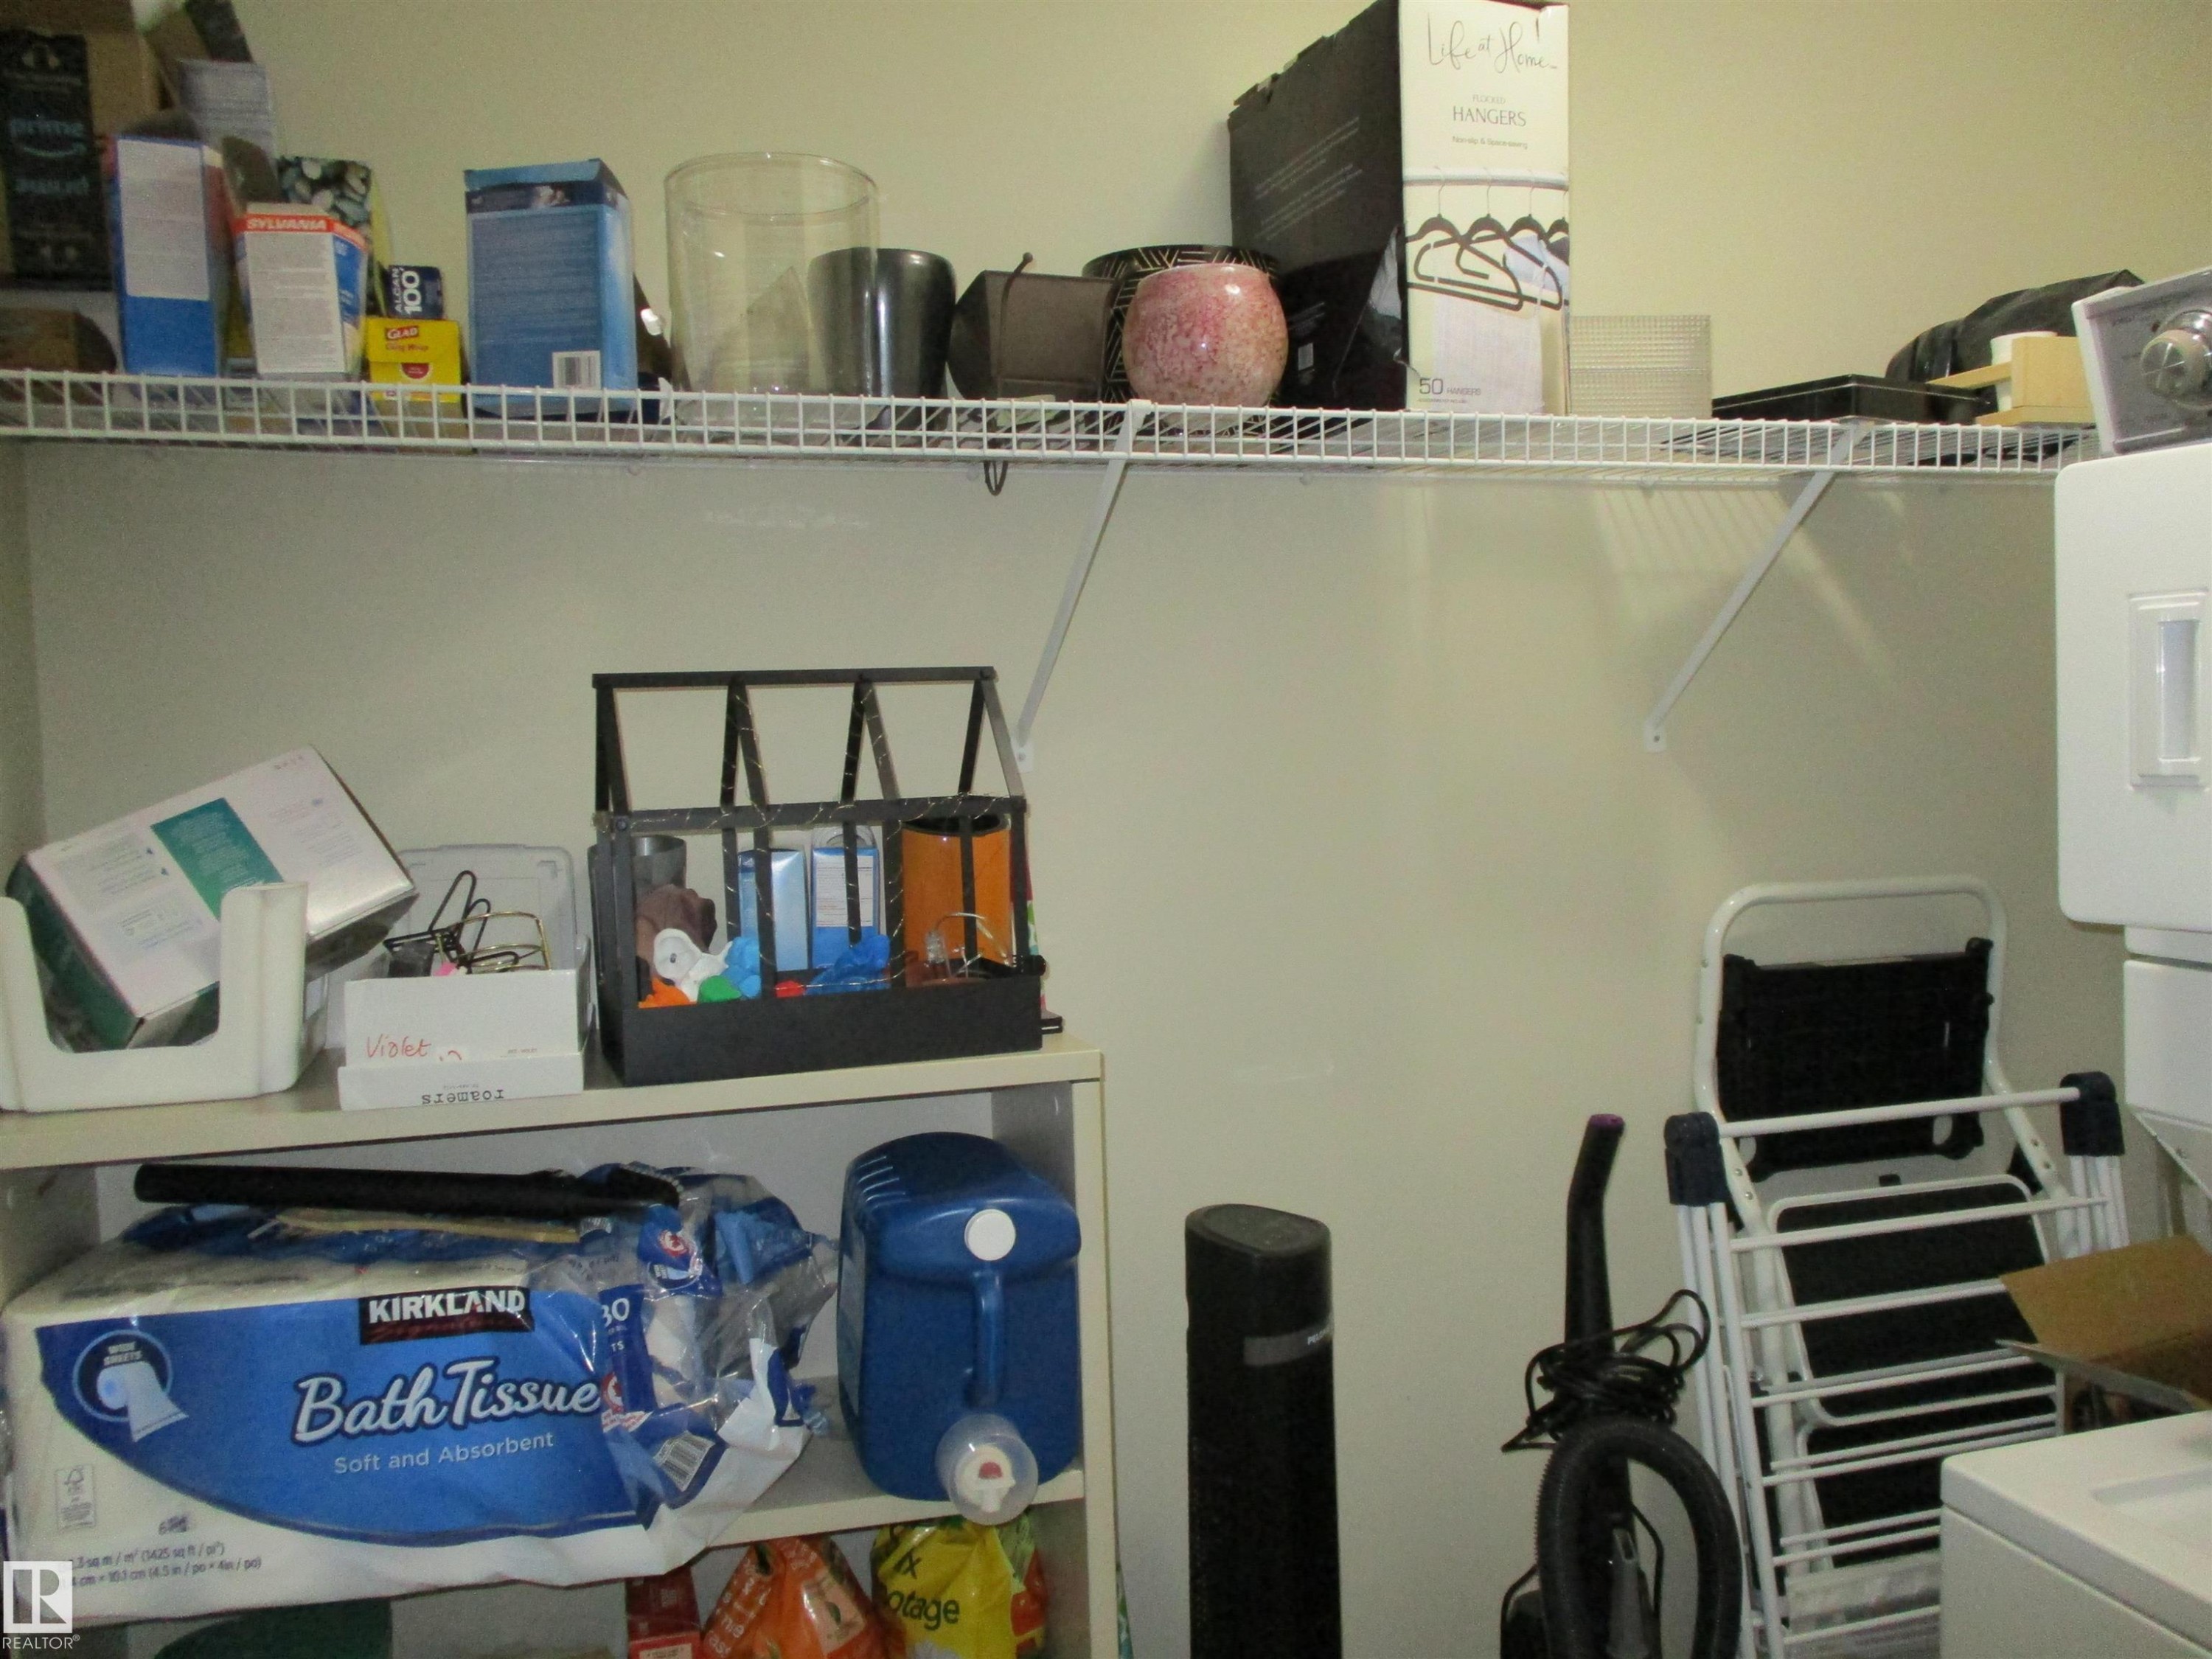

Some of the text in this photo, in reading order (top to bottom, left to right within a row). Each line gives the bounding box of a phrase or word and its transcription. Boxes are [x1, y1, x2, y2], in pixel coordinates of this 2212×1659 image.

[1427, 12, 1475, 70] Life
[1478, 35, 1492, 54] at
[1453, 105, 1527, 127] HANGERS
[246, 218, 328, 230] SYLVANIA
[392, 267, 404, 313] ALCAN
[386, 327, 419, 340] GLAD
[1419, 378, 1444, 395] 50
[368, 1032, 432, 1058] Violet
[421, 1089, 504, 1105] roamers
[369, 1290, 526, 1324] KIRKLAND
[293, 1358, 602, 1444] Bath Tissue
[334, 1431, 554, 1475] Soft and Absorbent
[888, 1590, 961, 1632] otage
